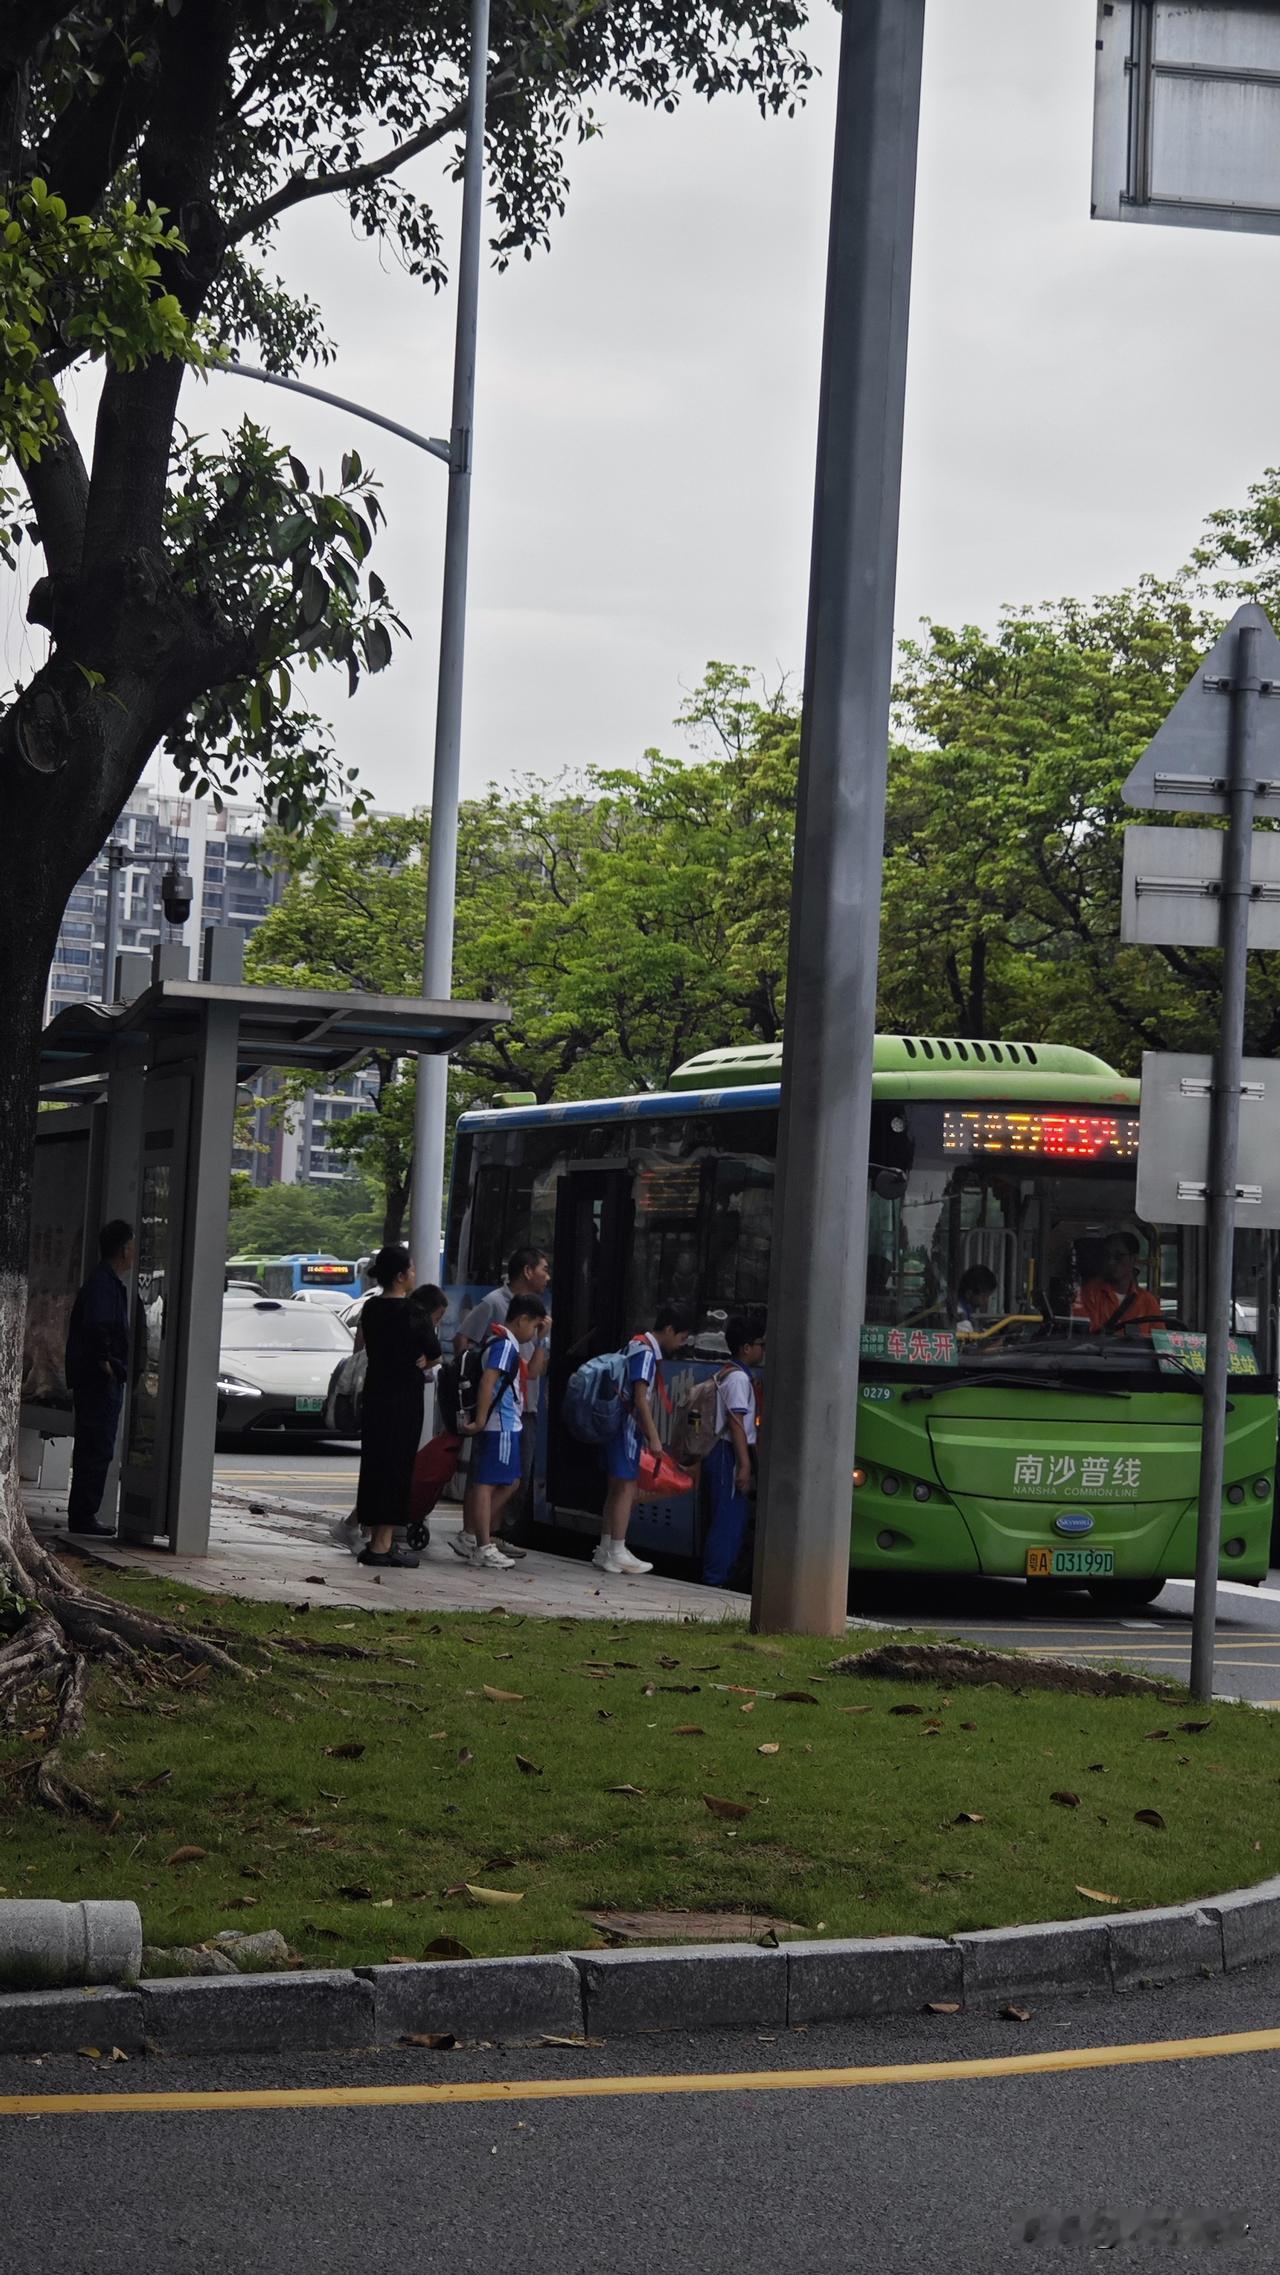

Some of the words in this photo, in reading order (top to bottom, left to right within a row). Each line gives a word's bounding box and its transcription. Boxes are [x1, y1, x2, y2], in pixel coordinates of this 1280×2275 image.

[887, 1328, 955, 1363] 车先开
[863, 1387, 890, 1399] 0279
[1013, 1454, 1142, 1488] 南沙普线
[1012, 1486, 1057, 1496] NANSHA
[1064, 1487, 1113, 1497] COMMON
[1115, 1488, 1138, 1498] LINE
